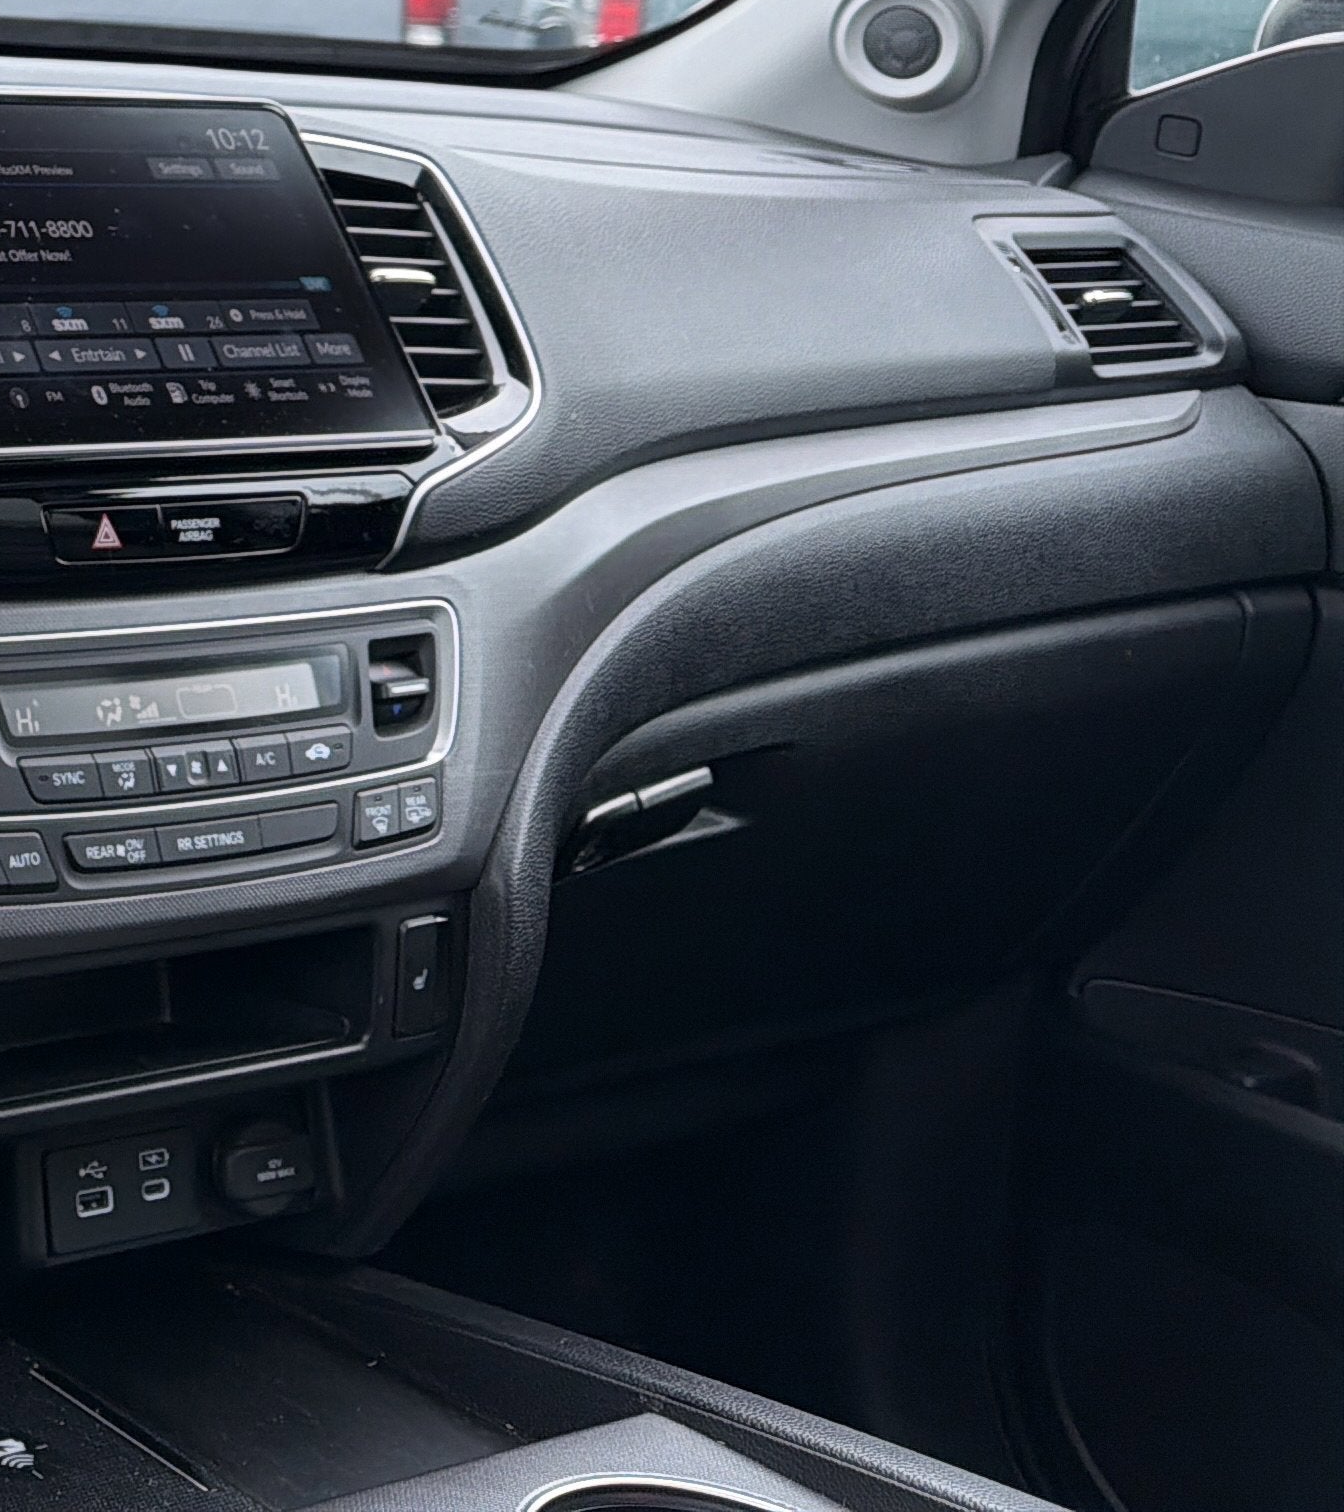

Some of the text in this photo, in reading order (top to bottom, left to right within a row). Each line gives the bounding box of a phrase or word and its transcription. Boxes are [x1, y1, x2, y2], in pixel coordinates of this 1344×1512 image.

[206, 128, 269, 150] 10:12
[8, 249, 39, 262] Offer
[112, 318, 128, 331] 11
[206, 316, 224, 329] 26
[223, 342, 301, 358] Channel List
[316, 342, 351, 356] More
[171, 517, 221, 530] PASSENGER
[255, 752, 276, 766] A/C
[52, 771, 85, 787] SYNC
[177, 831, 244, 851] RR SETTINGS
[86, 844, 114, 860] REAR
[126, 850, 146, 863] OFF
[9, 852, 41, 868] AUTO
